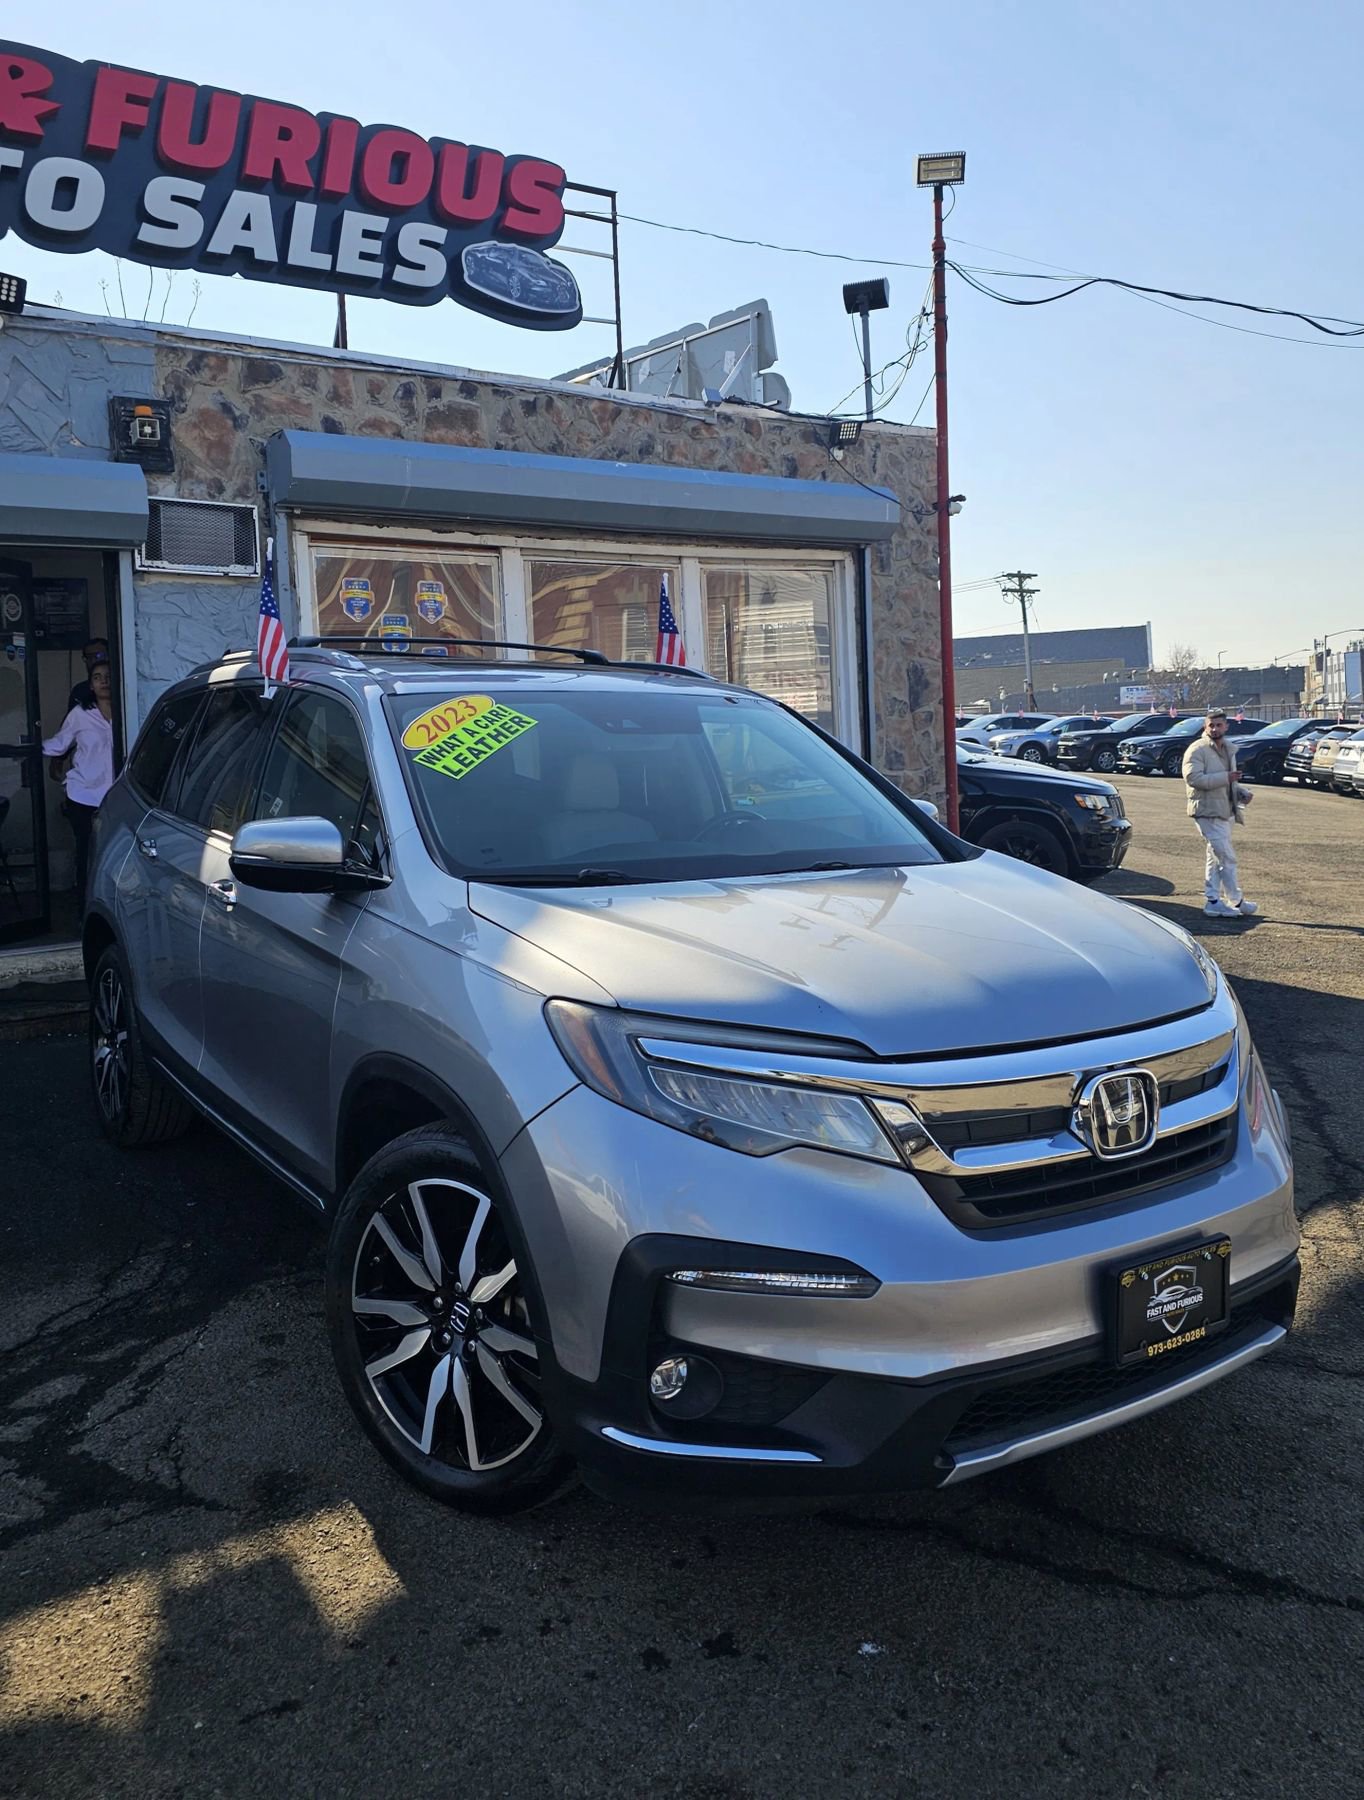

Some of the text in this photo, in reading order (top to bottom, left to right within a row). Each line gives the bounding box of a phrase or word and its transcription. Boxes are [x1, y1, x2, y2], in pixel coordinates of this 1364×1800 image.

[86, 66, 566, 237] FURIOUS
[137, 176, 448, 287] SALES
[416, 699, 478, 744] 2023
[419, 705, 510, 766] WHAT A CAR!
[441, 715, 532, 777] LEATHER
[1146, 1305, 1163, 1318] FAST
[1162, 1301, 1177, 1314] AND
[1177, 1293, 1204, 1309] FURIOUS
[1147, 1327, 1206, 1357] 973-623-0284
